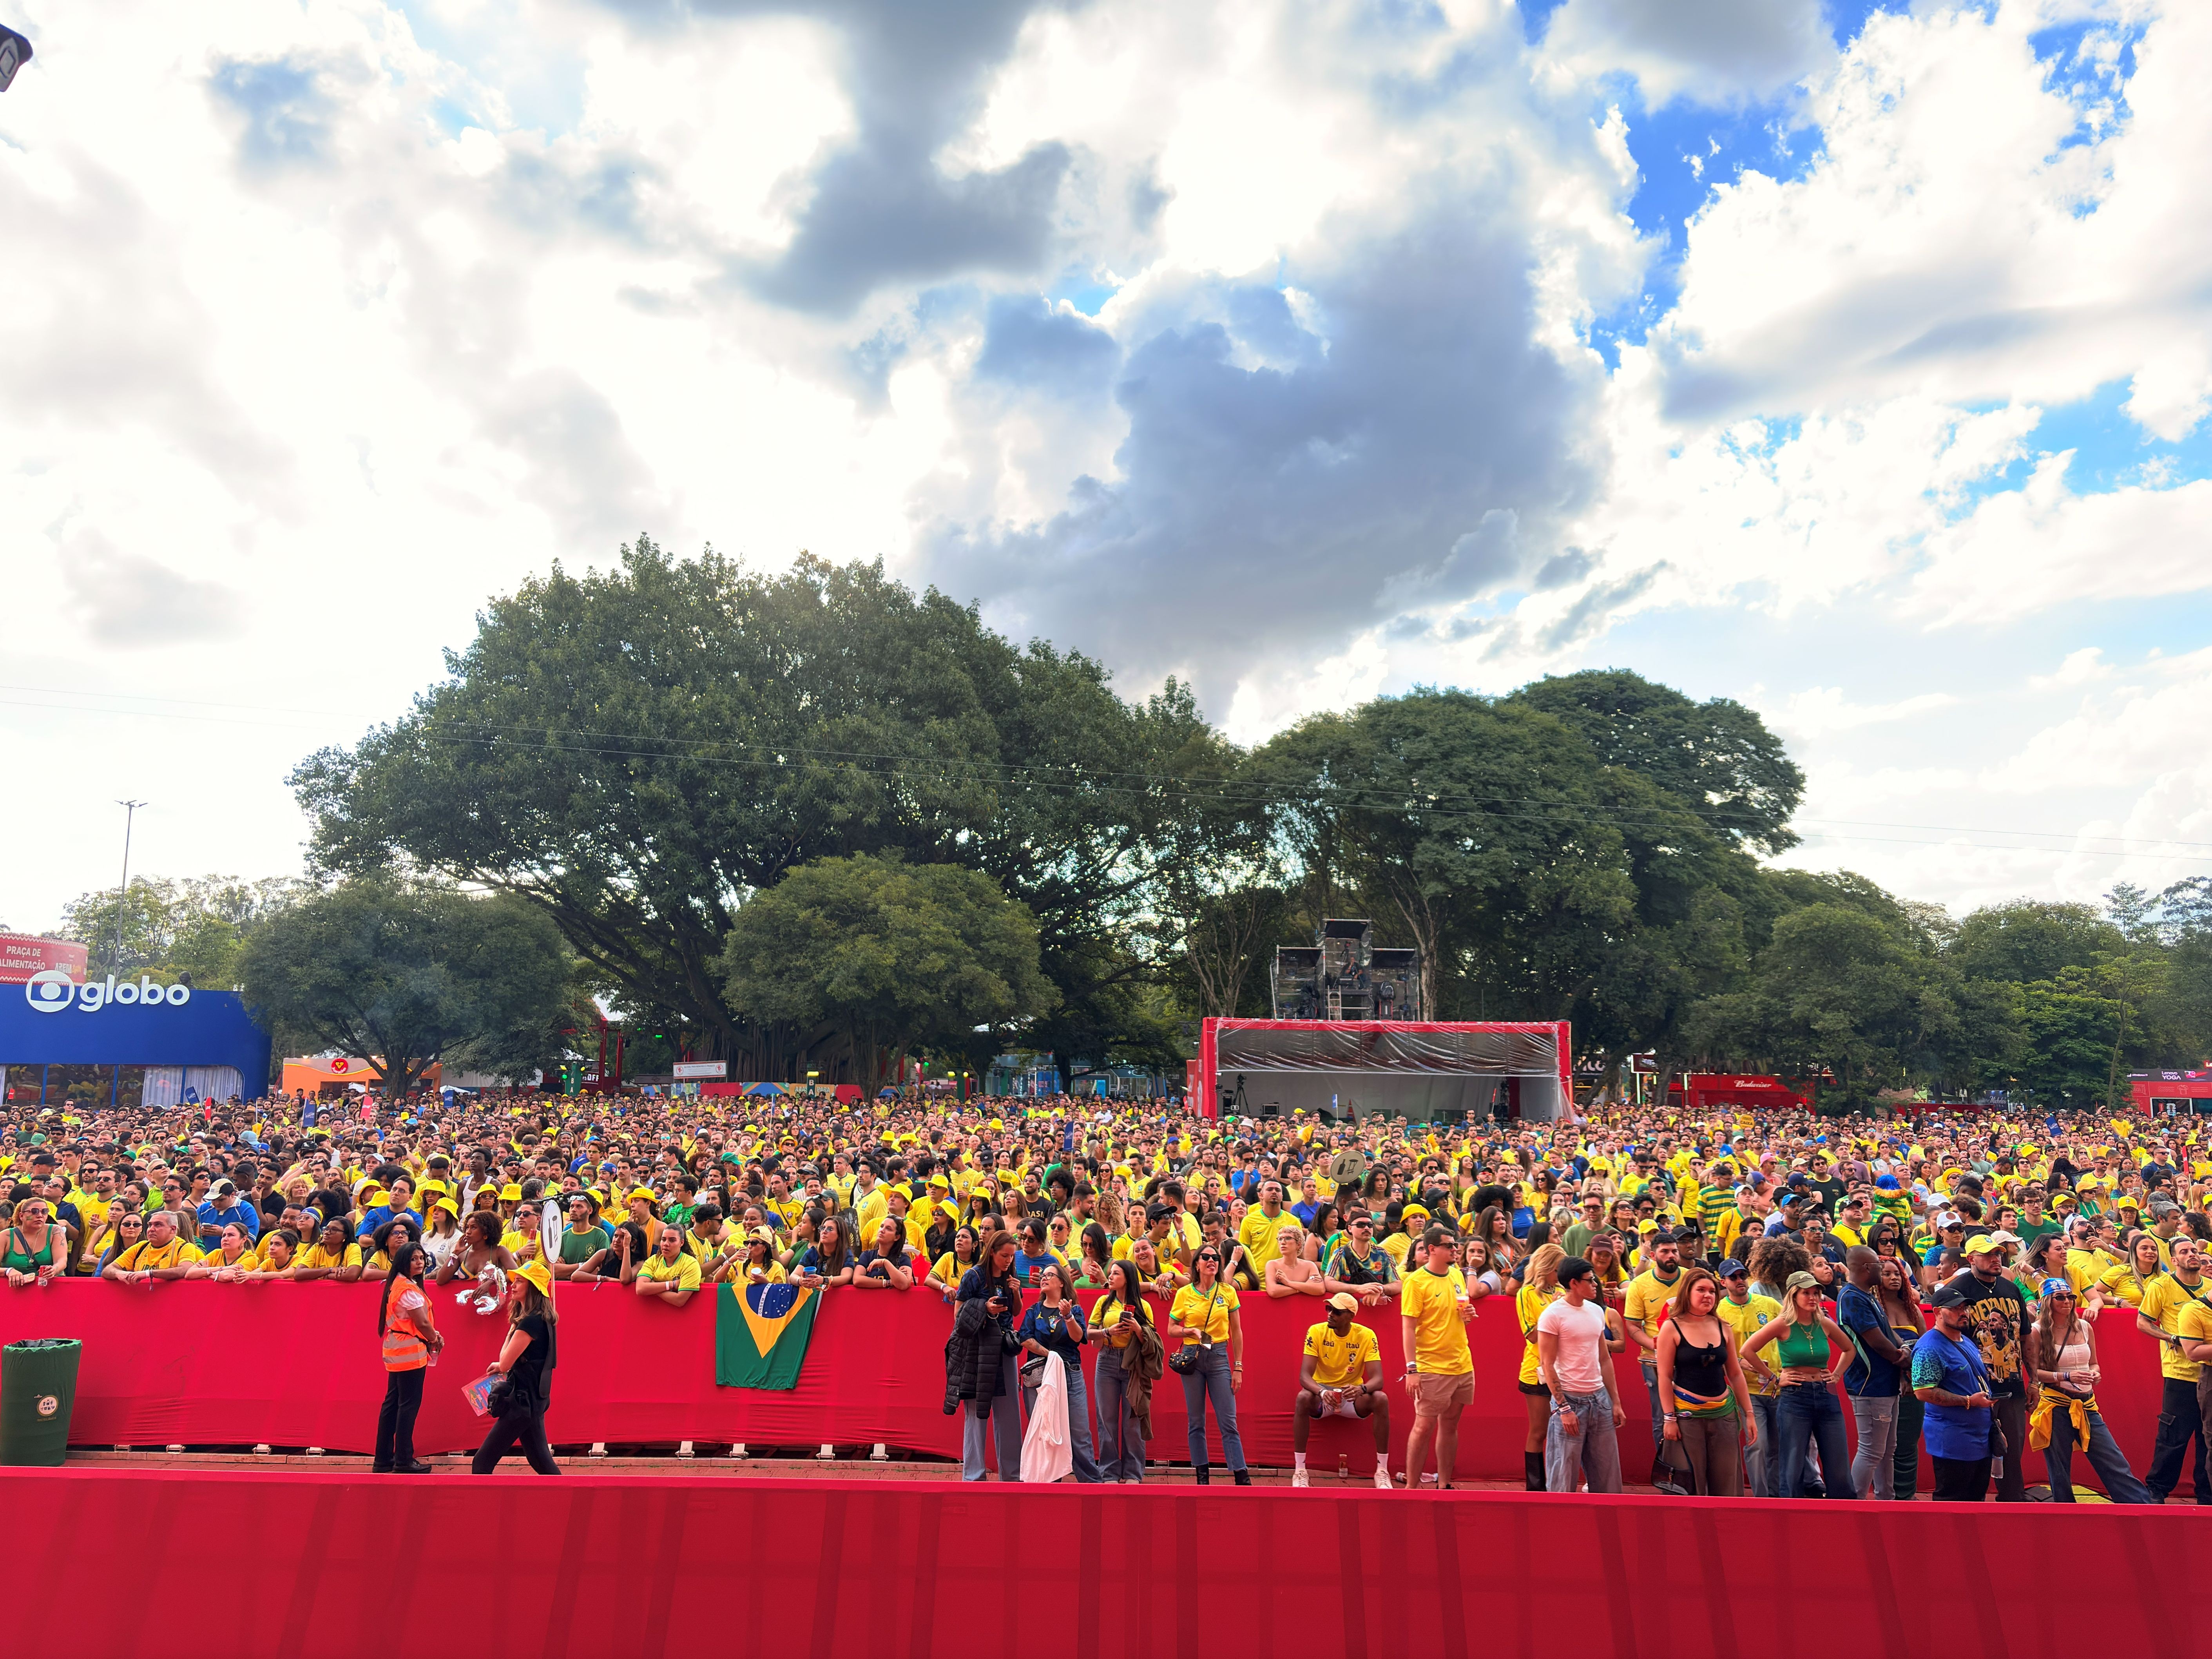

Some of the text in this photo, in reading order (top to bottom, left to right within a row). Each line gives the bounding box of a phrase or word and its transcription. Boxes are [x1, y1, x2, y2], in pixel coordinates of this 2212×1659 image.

[6, 945, 41, 958] PRAÇA DE
[55, 962, 72, 974] ARENA
[78, 974, 190, 1012] globo
